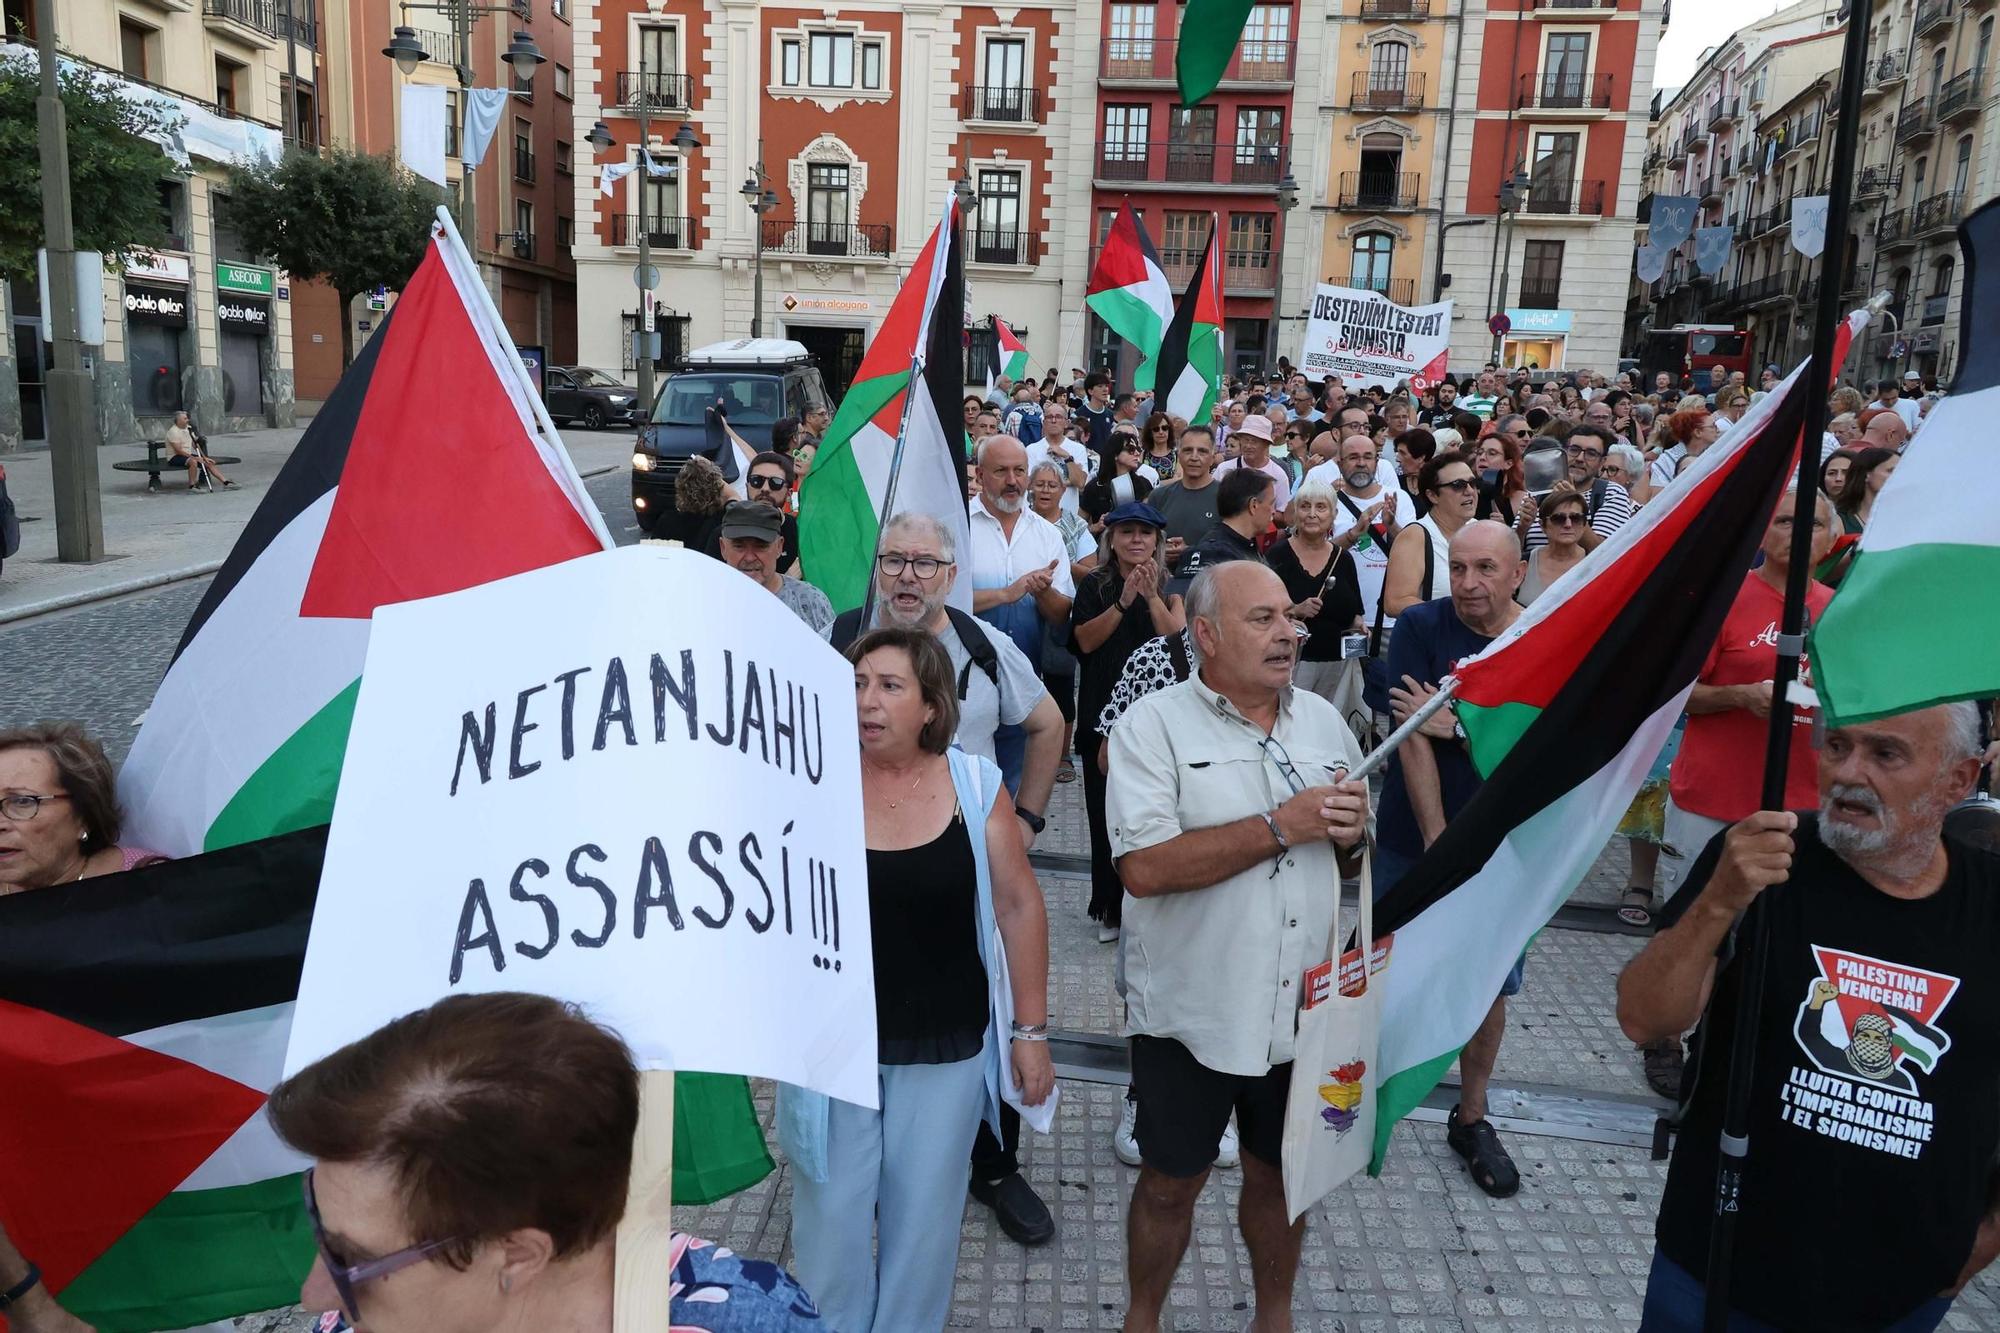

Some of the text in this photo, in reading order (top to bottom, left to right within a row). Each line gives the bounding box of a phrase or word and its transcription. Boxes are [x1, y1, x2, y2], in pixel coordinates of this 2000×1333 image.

[228, 269, 262, 285] ASECOR
[826, 299, 868, 311] alcoyana
[1313, 294, 1443, 336] DESTRUÏM L'ESTAT
[1340, 324, 1406, 357] SIONISTA
[449, 648, 823, 797] NETANJAHU
[1836, 958, 1929, 995] PALESTINA
[1838, 978, 1923, 1013] VENCERÀ!
[1780, 1083, 1934, 1142] L'IMPERIALISME
[1789, 1066, 1934, 1122] LLUITA CONTRA
[1781, 1105, 1923, 1160] I EL SIONISME!
